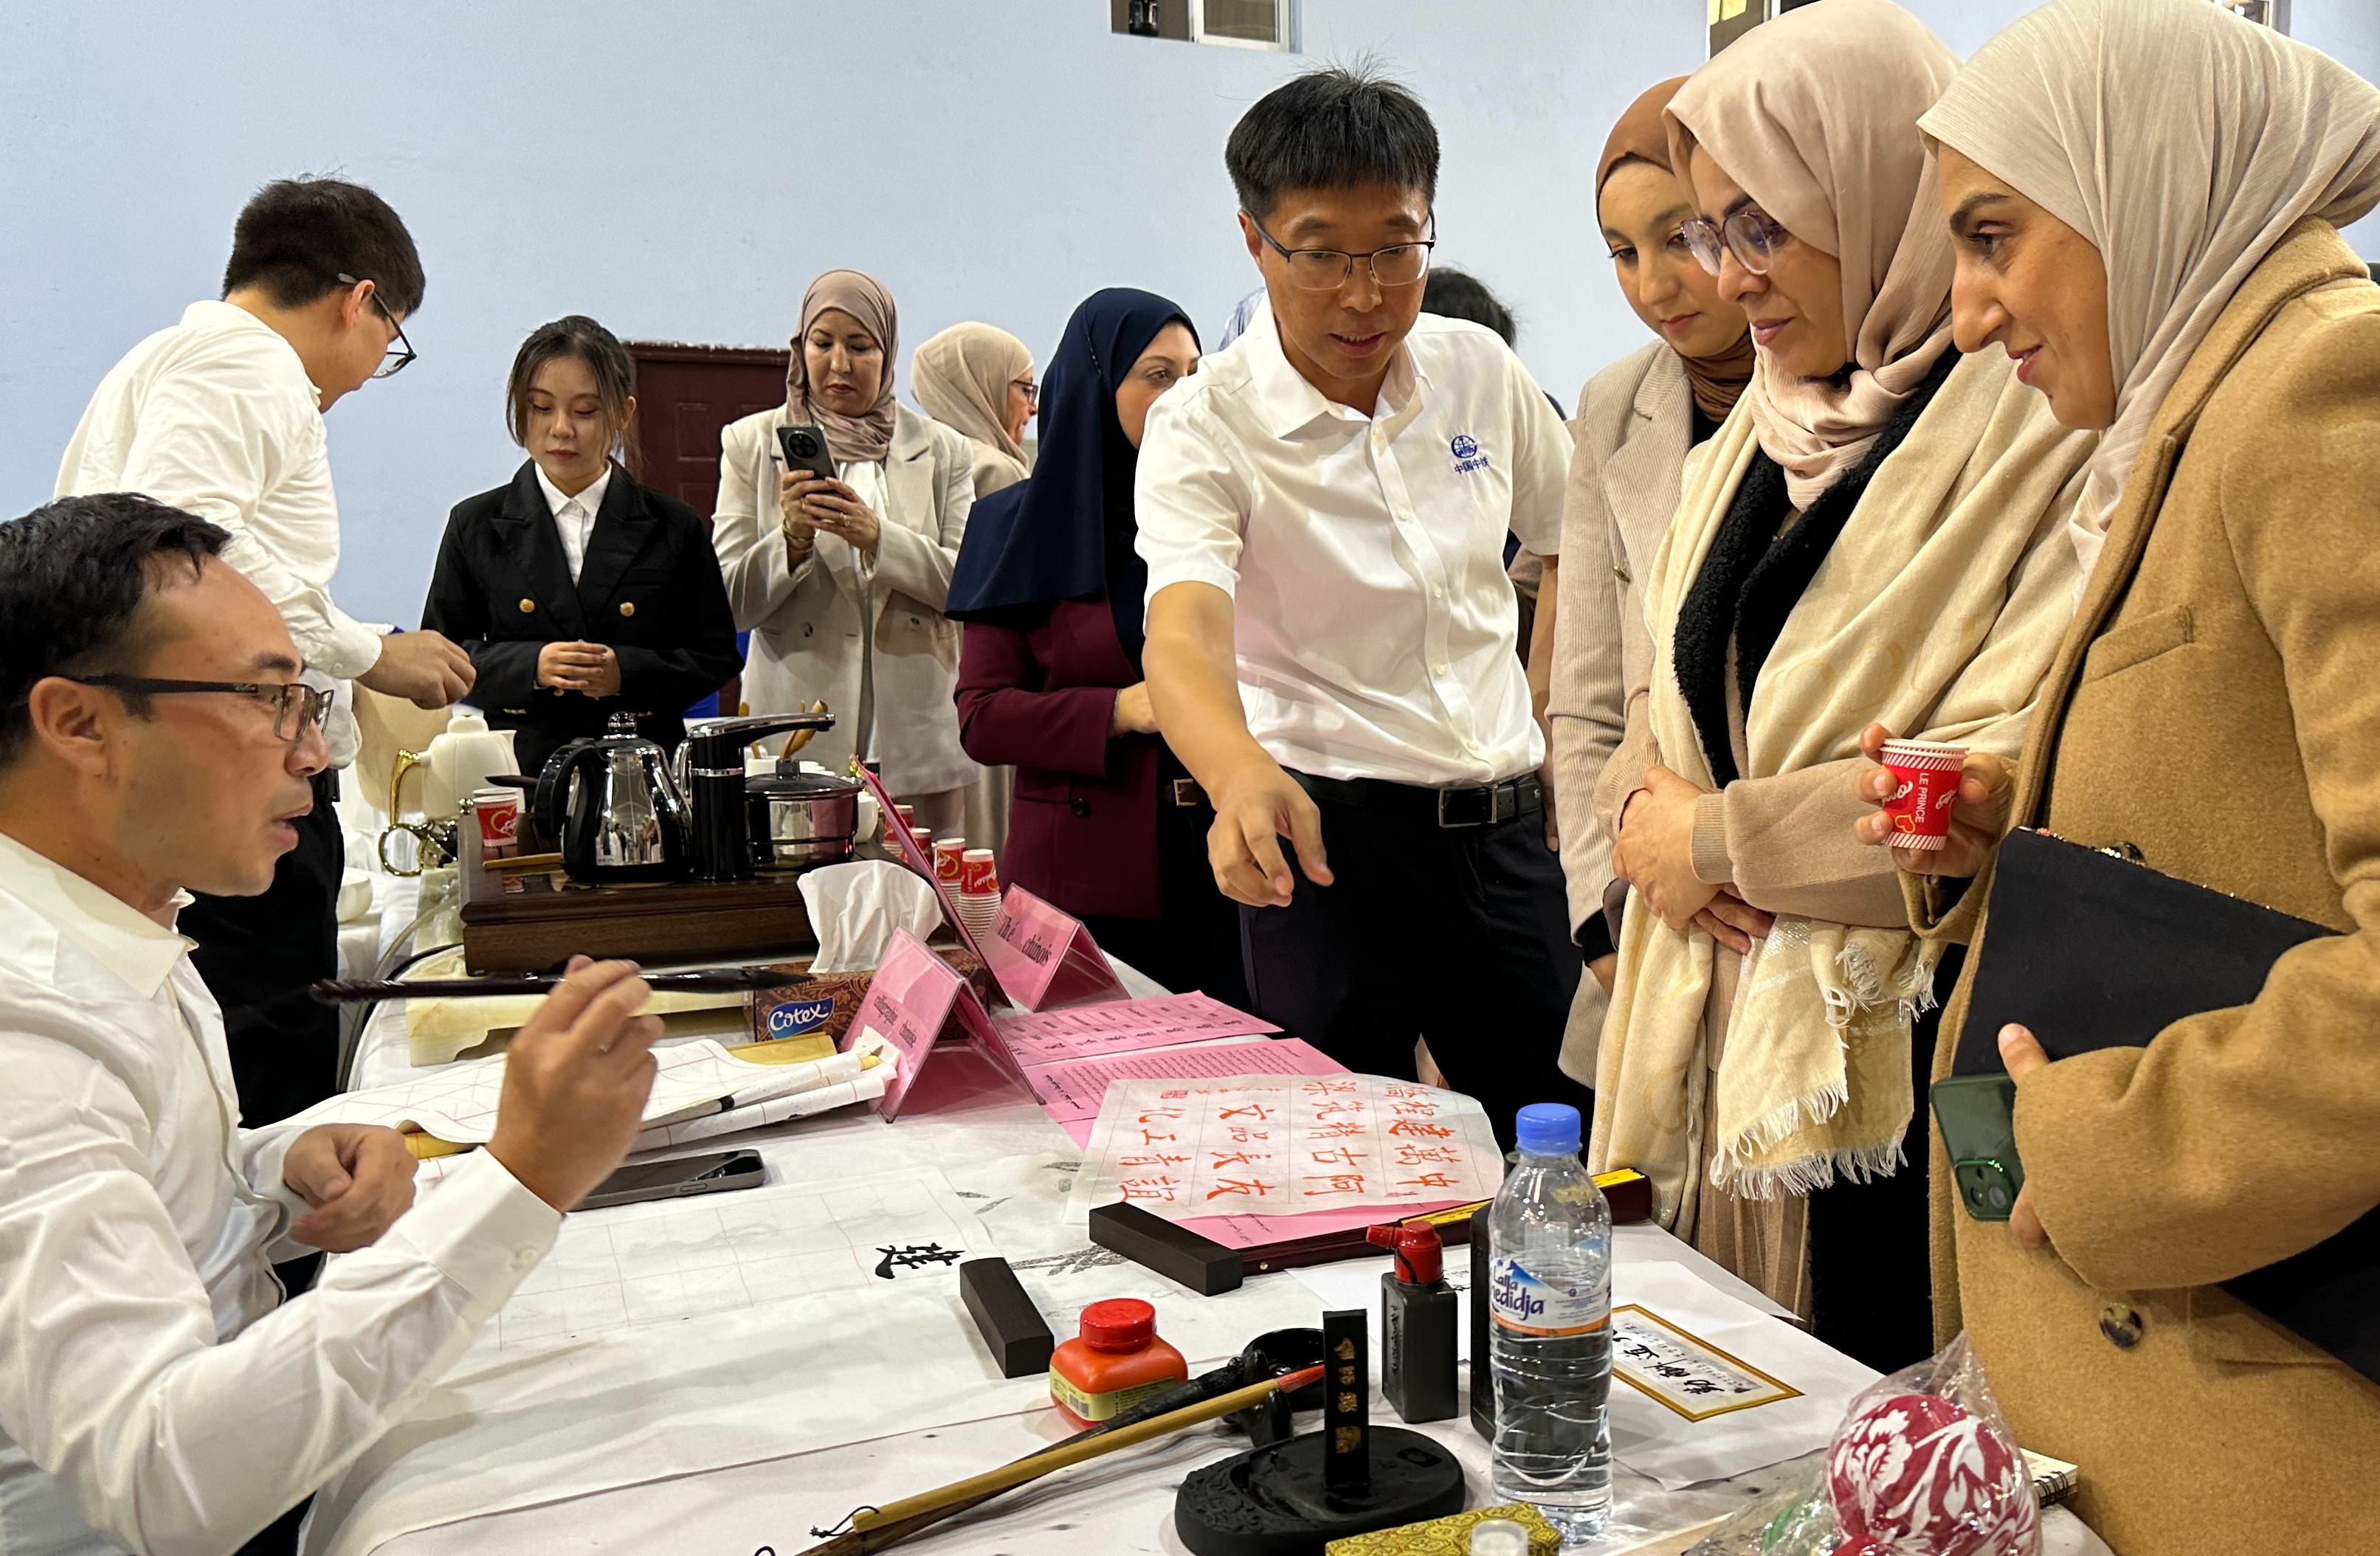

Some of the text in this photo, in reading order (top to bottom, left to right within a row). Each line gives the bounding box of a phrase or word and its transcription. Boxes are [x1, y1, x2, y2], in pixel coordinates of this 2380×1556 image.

[1915, 772, 1930, 823] LE PRINCE
[998, 915, 1052, 967] Thé chinois
[770, 1003, 829, 1031] Cotex
[1493, 1265, 1518, 1291] Lalla
[1491, 1285, 1545, 1321] edidja
